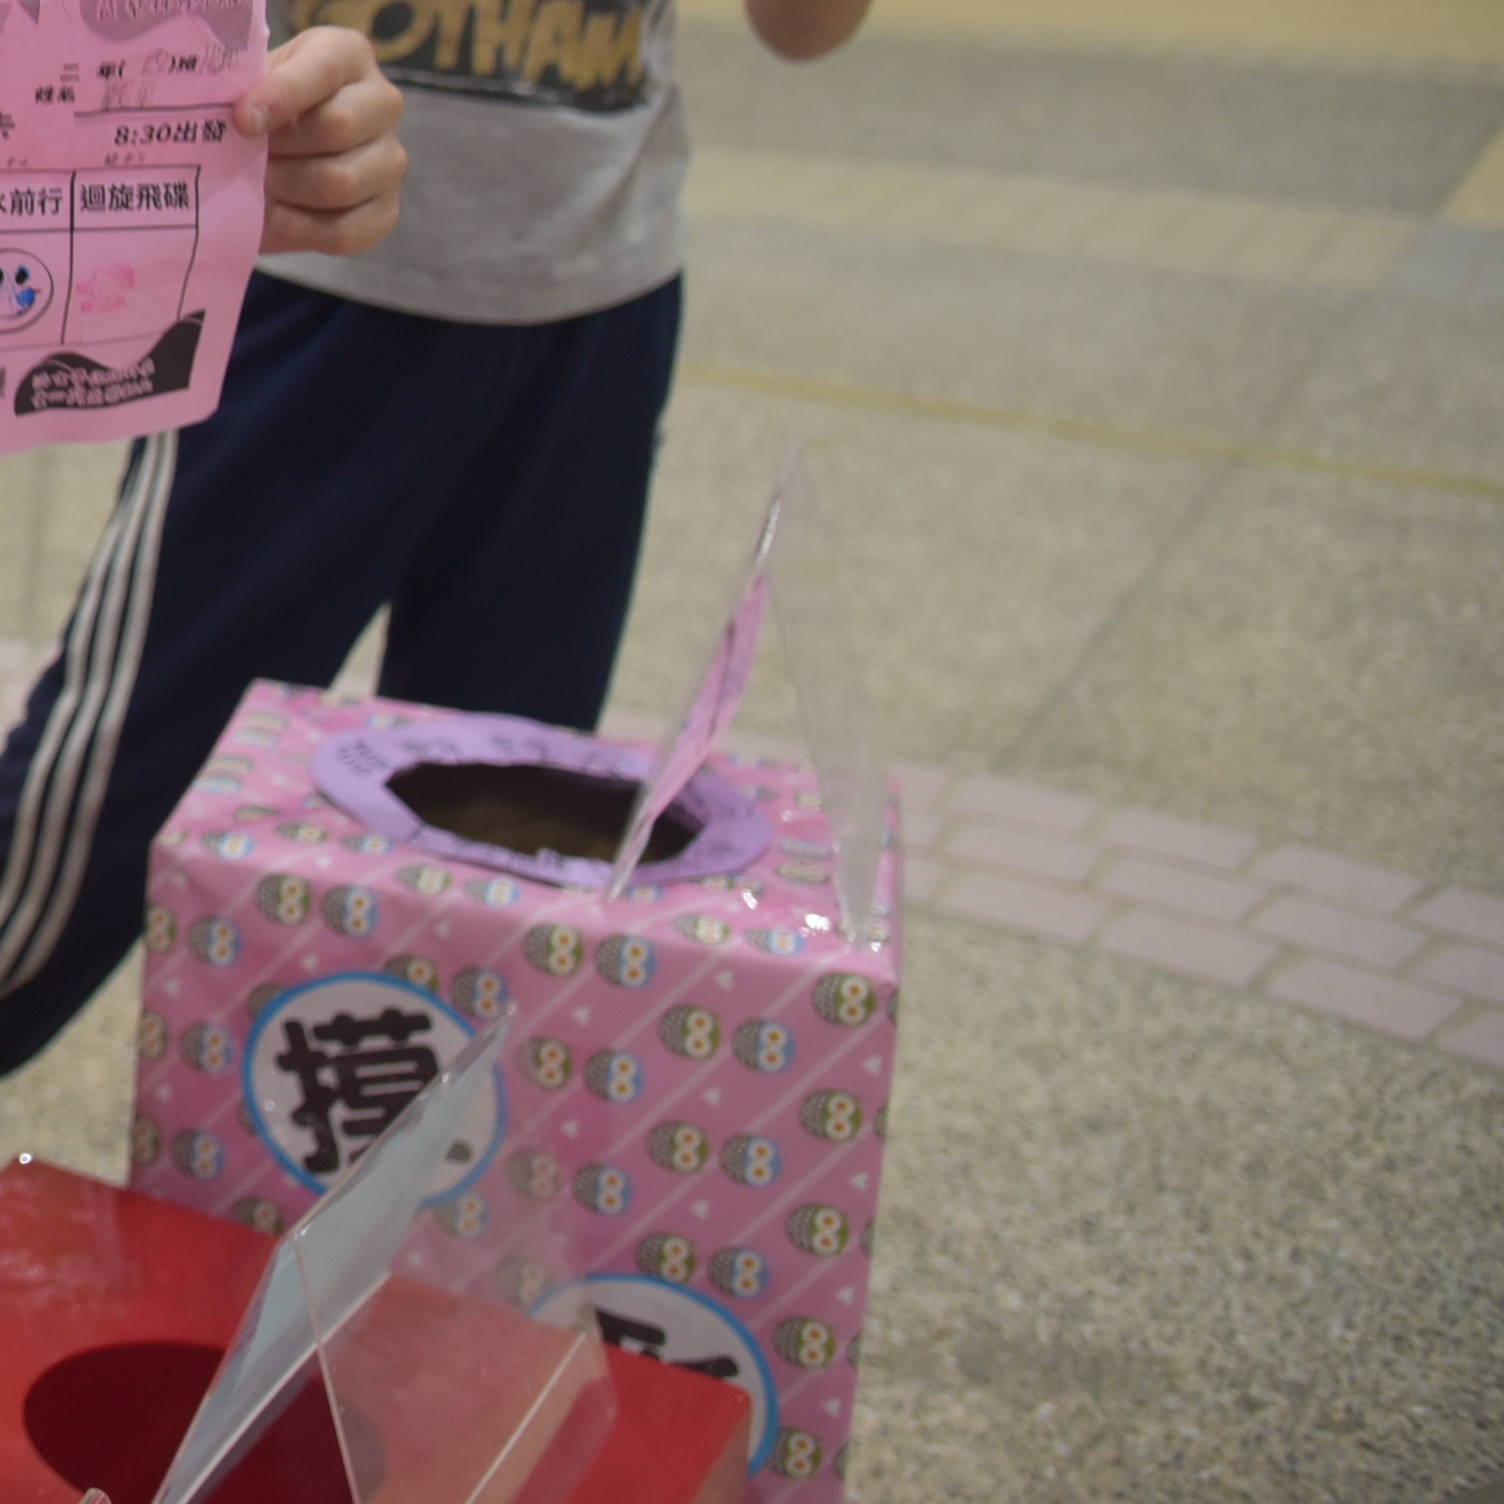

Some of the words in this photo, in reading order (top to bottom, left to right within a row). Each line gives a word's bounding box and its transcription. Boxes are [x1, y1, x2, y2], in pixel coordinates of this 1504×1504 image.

[114, 119, 227, 146] 8:30出發
[79, 181, 191, 213] 迴旋飛碟
